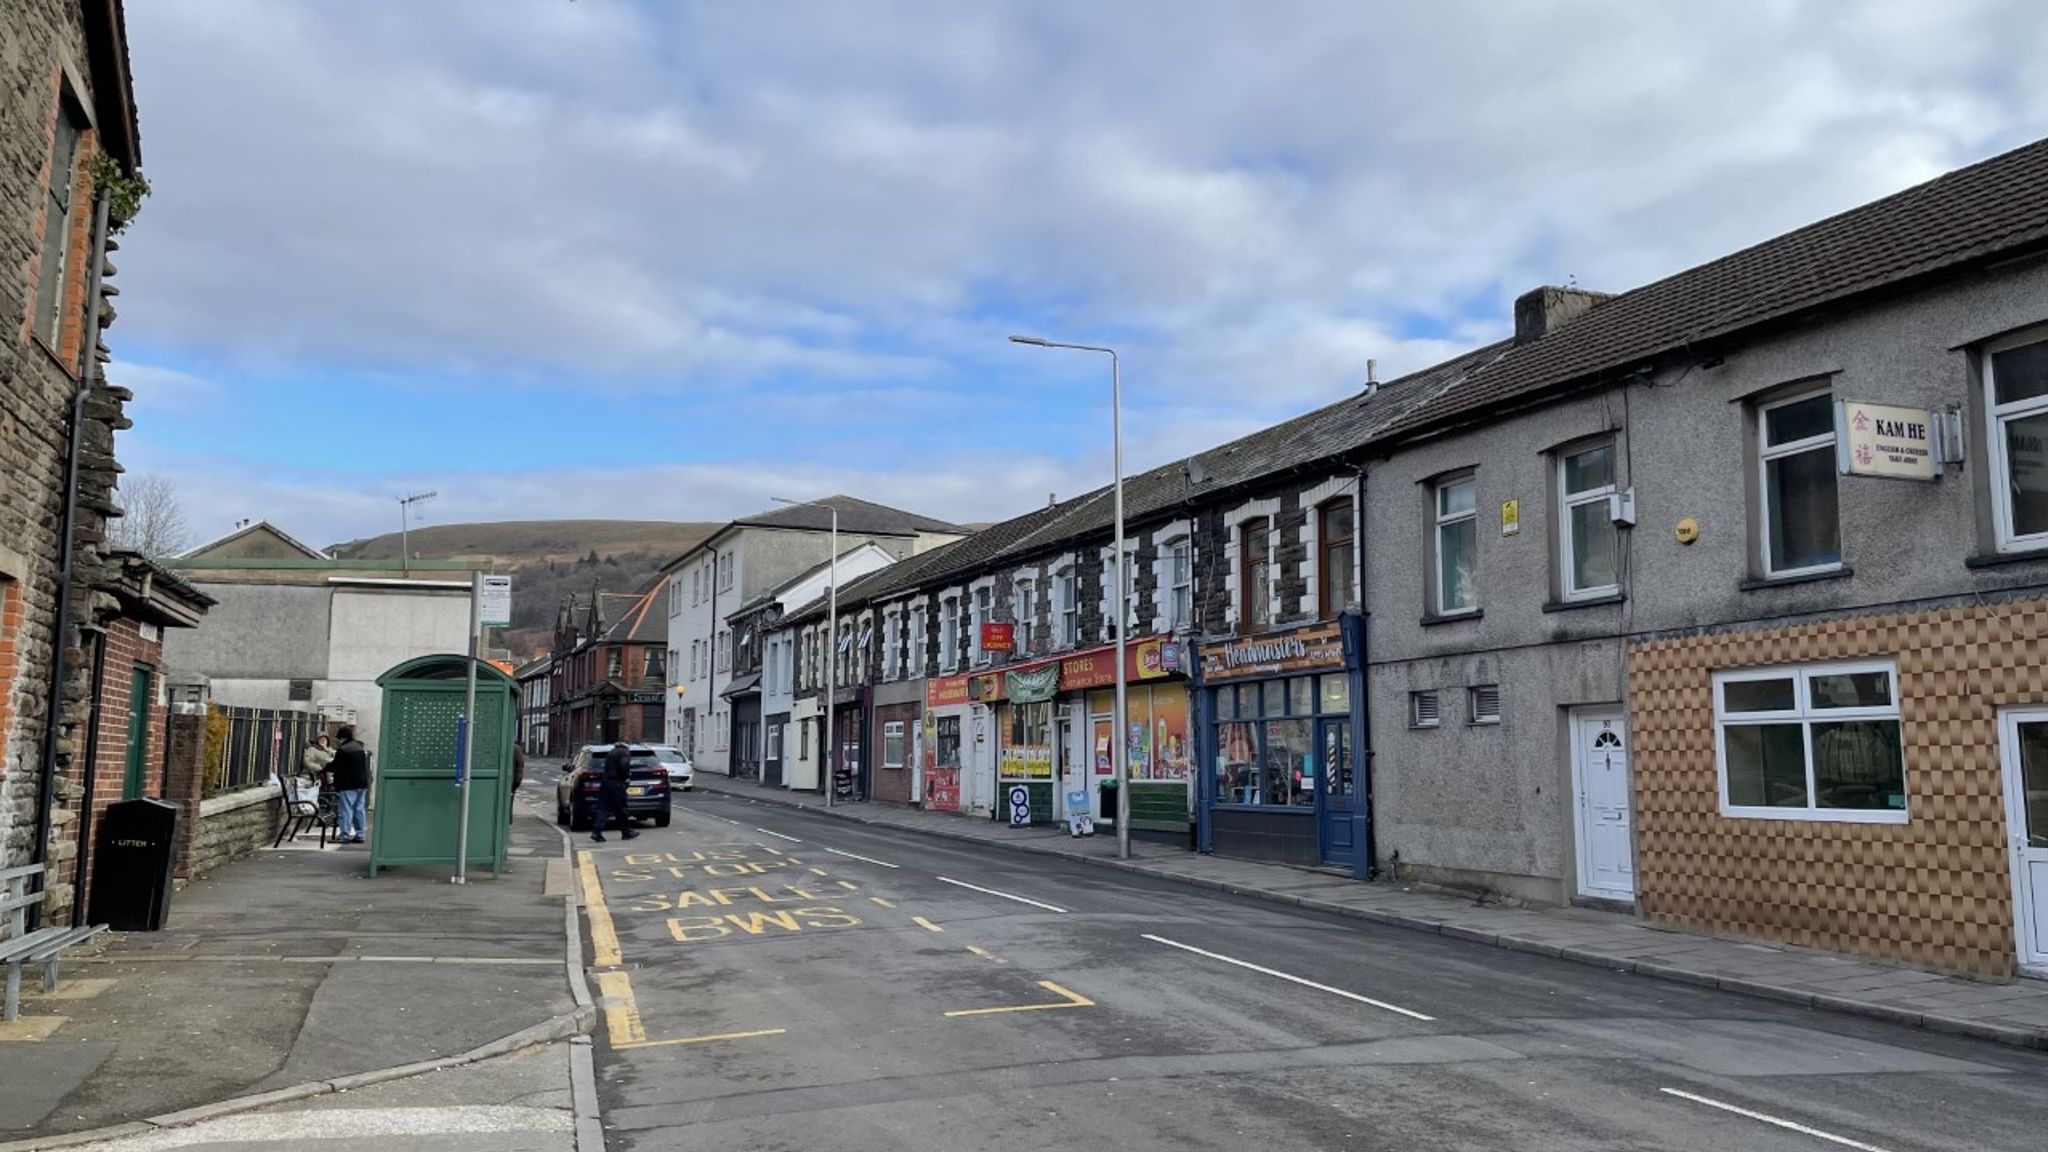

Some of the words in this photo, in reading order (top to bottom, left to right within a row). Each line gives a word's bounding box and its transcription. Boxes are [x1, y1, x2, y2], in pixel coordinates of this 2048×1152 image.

[1876, 419, 1905, 438] KAM
[1908, 423, 1926, 441] HE
[1876, 444, 1899, 454] ENGLISH
[1905, 448, 1928, 457] CHINESE
[1889, 455, 1902, 463] TAKE
[991, 634, 1004, 642] OFF
[1224, 634, 1307, 668] Headmasters
[1063, 658, 1094, 676] STORES
[118, 839, 147, 847] LITTER
[624, 850, 748, 865] BUS
[611, 861, 787, 882] STOP
[631, 883, 856, 912] SAFLE
[666, 907, 863, 942] BWS
